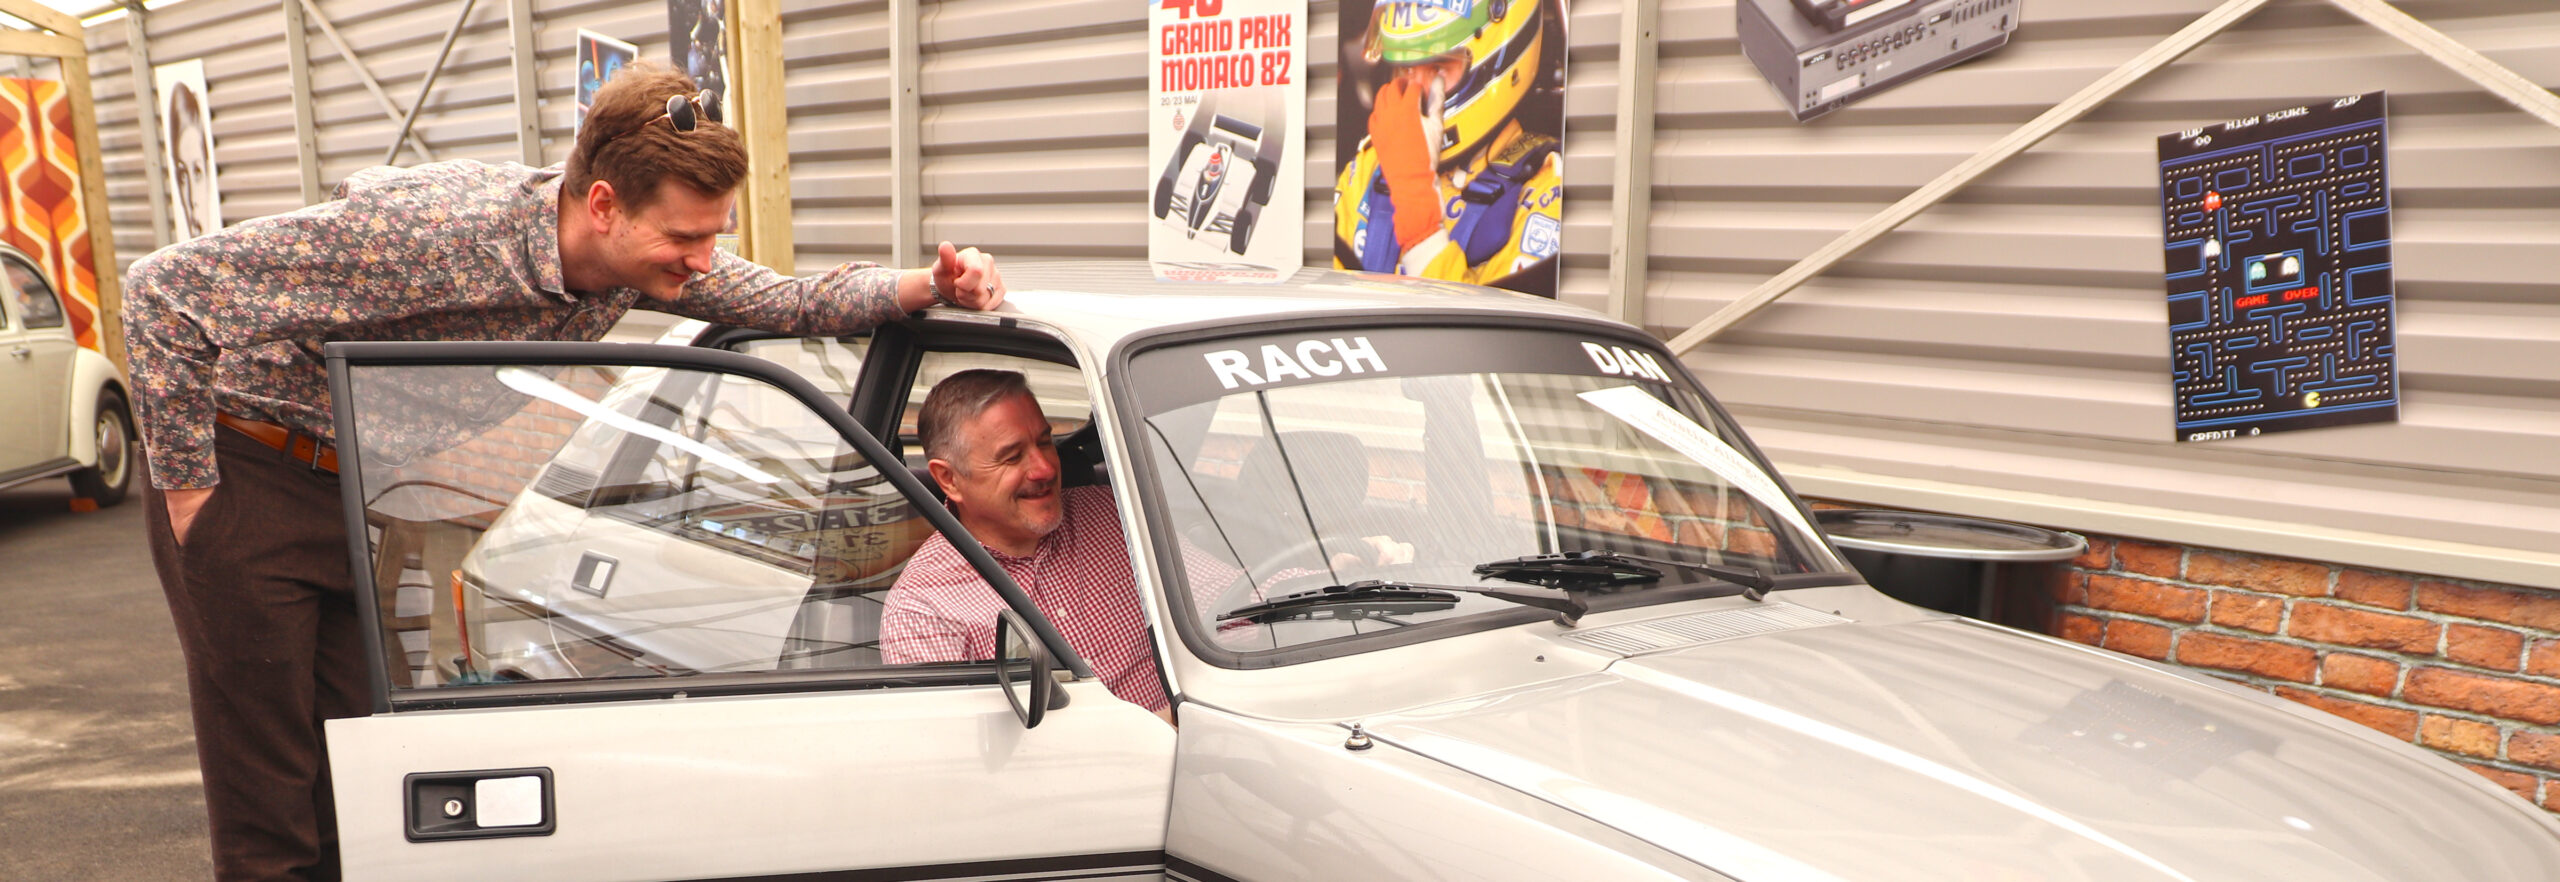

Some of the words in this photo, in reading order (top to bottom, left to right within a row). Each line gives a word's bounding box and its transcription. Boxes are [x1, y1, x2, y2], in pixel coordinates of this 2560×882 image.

[1161, 19, 1233, 56] GRAND
[1239, 13, 1292, 50] PRIX
[1161, 53, 1254, 92] MONACO
[1261, 50, 1291, 86] 82
[2235, 294, 2269, 309] GAME
[2283, 286, 2319, 301] OVER
[1204, 336, 1388, 390] RACH
[1581, 341, 1672, 383] DAN
